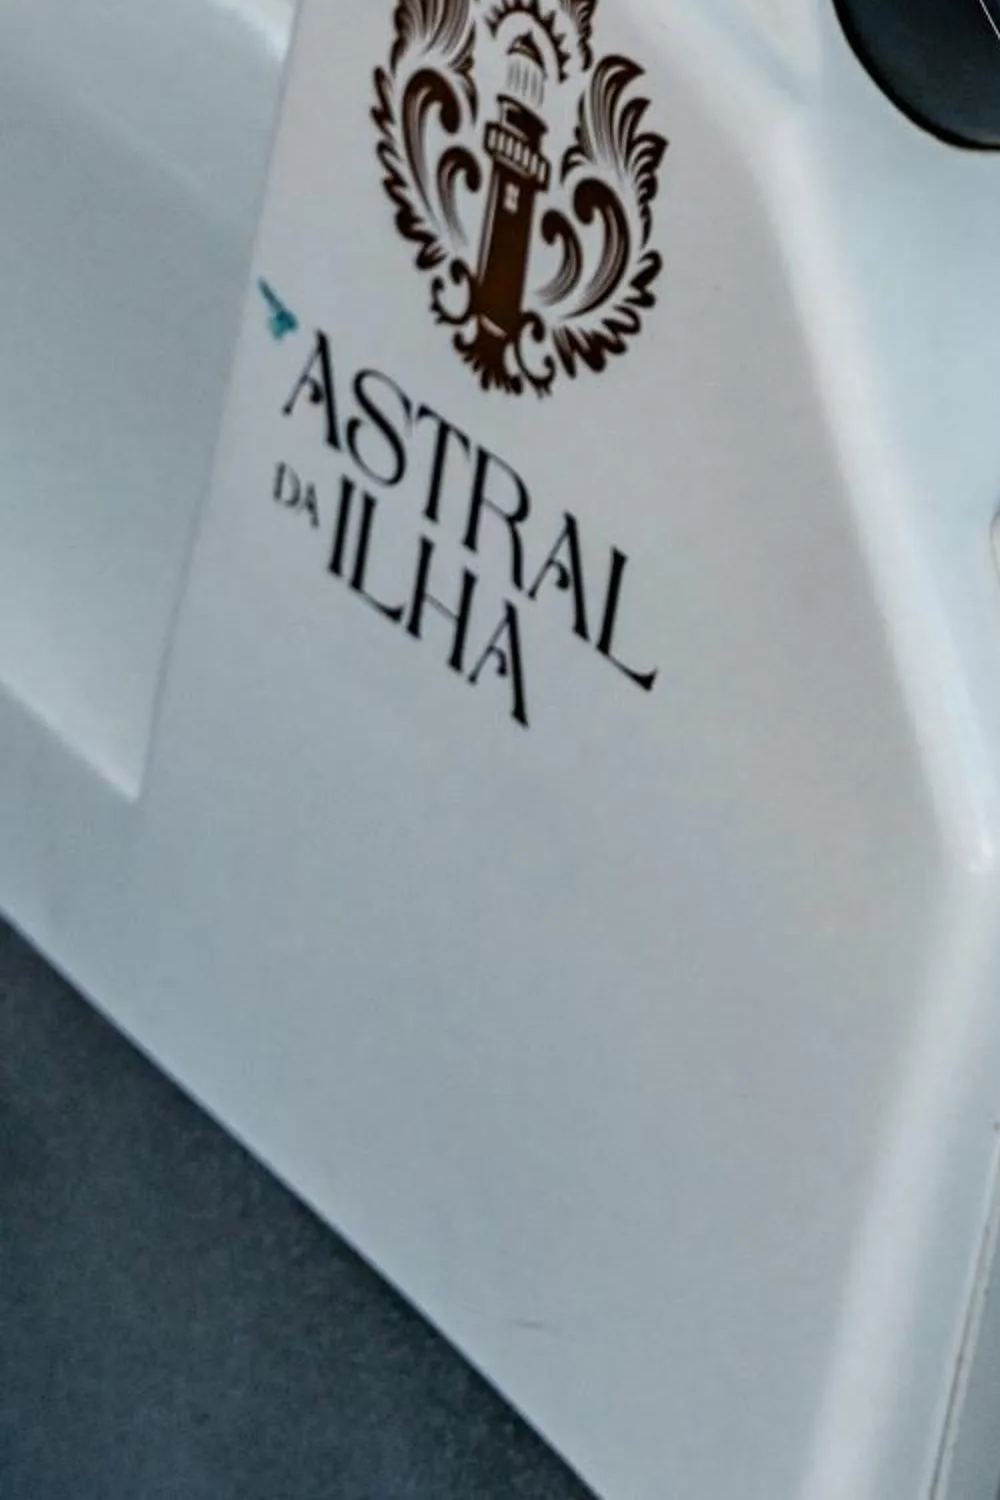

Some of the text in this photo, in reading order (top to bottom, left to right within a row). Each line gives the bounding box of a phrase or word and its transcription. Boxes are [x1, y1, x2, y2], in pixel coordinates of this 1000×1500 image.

[273, 461, 529, 728] DA ILHA
[283, 329, 659, 691] ASTRAL
